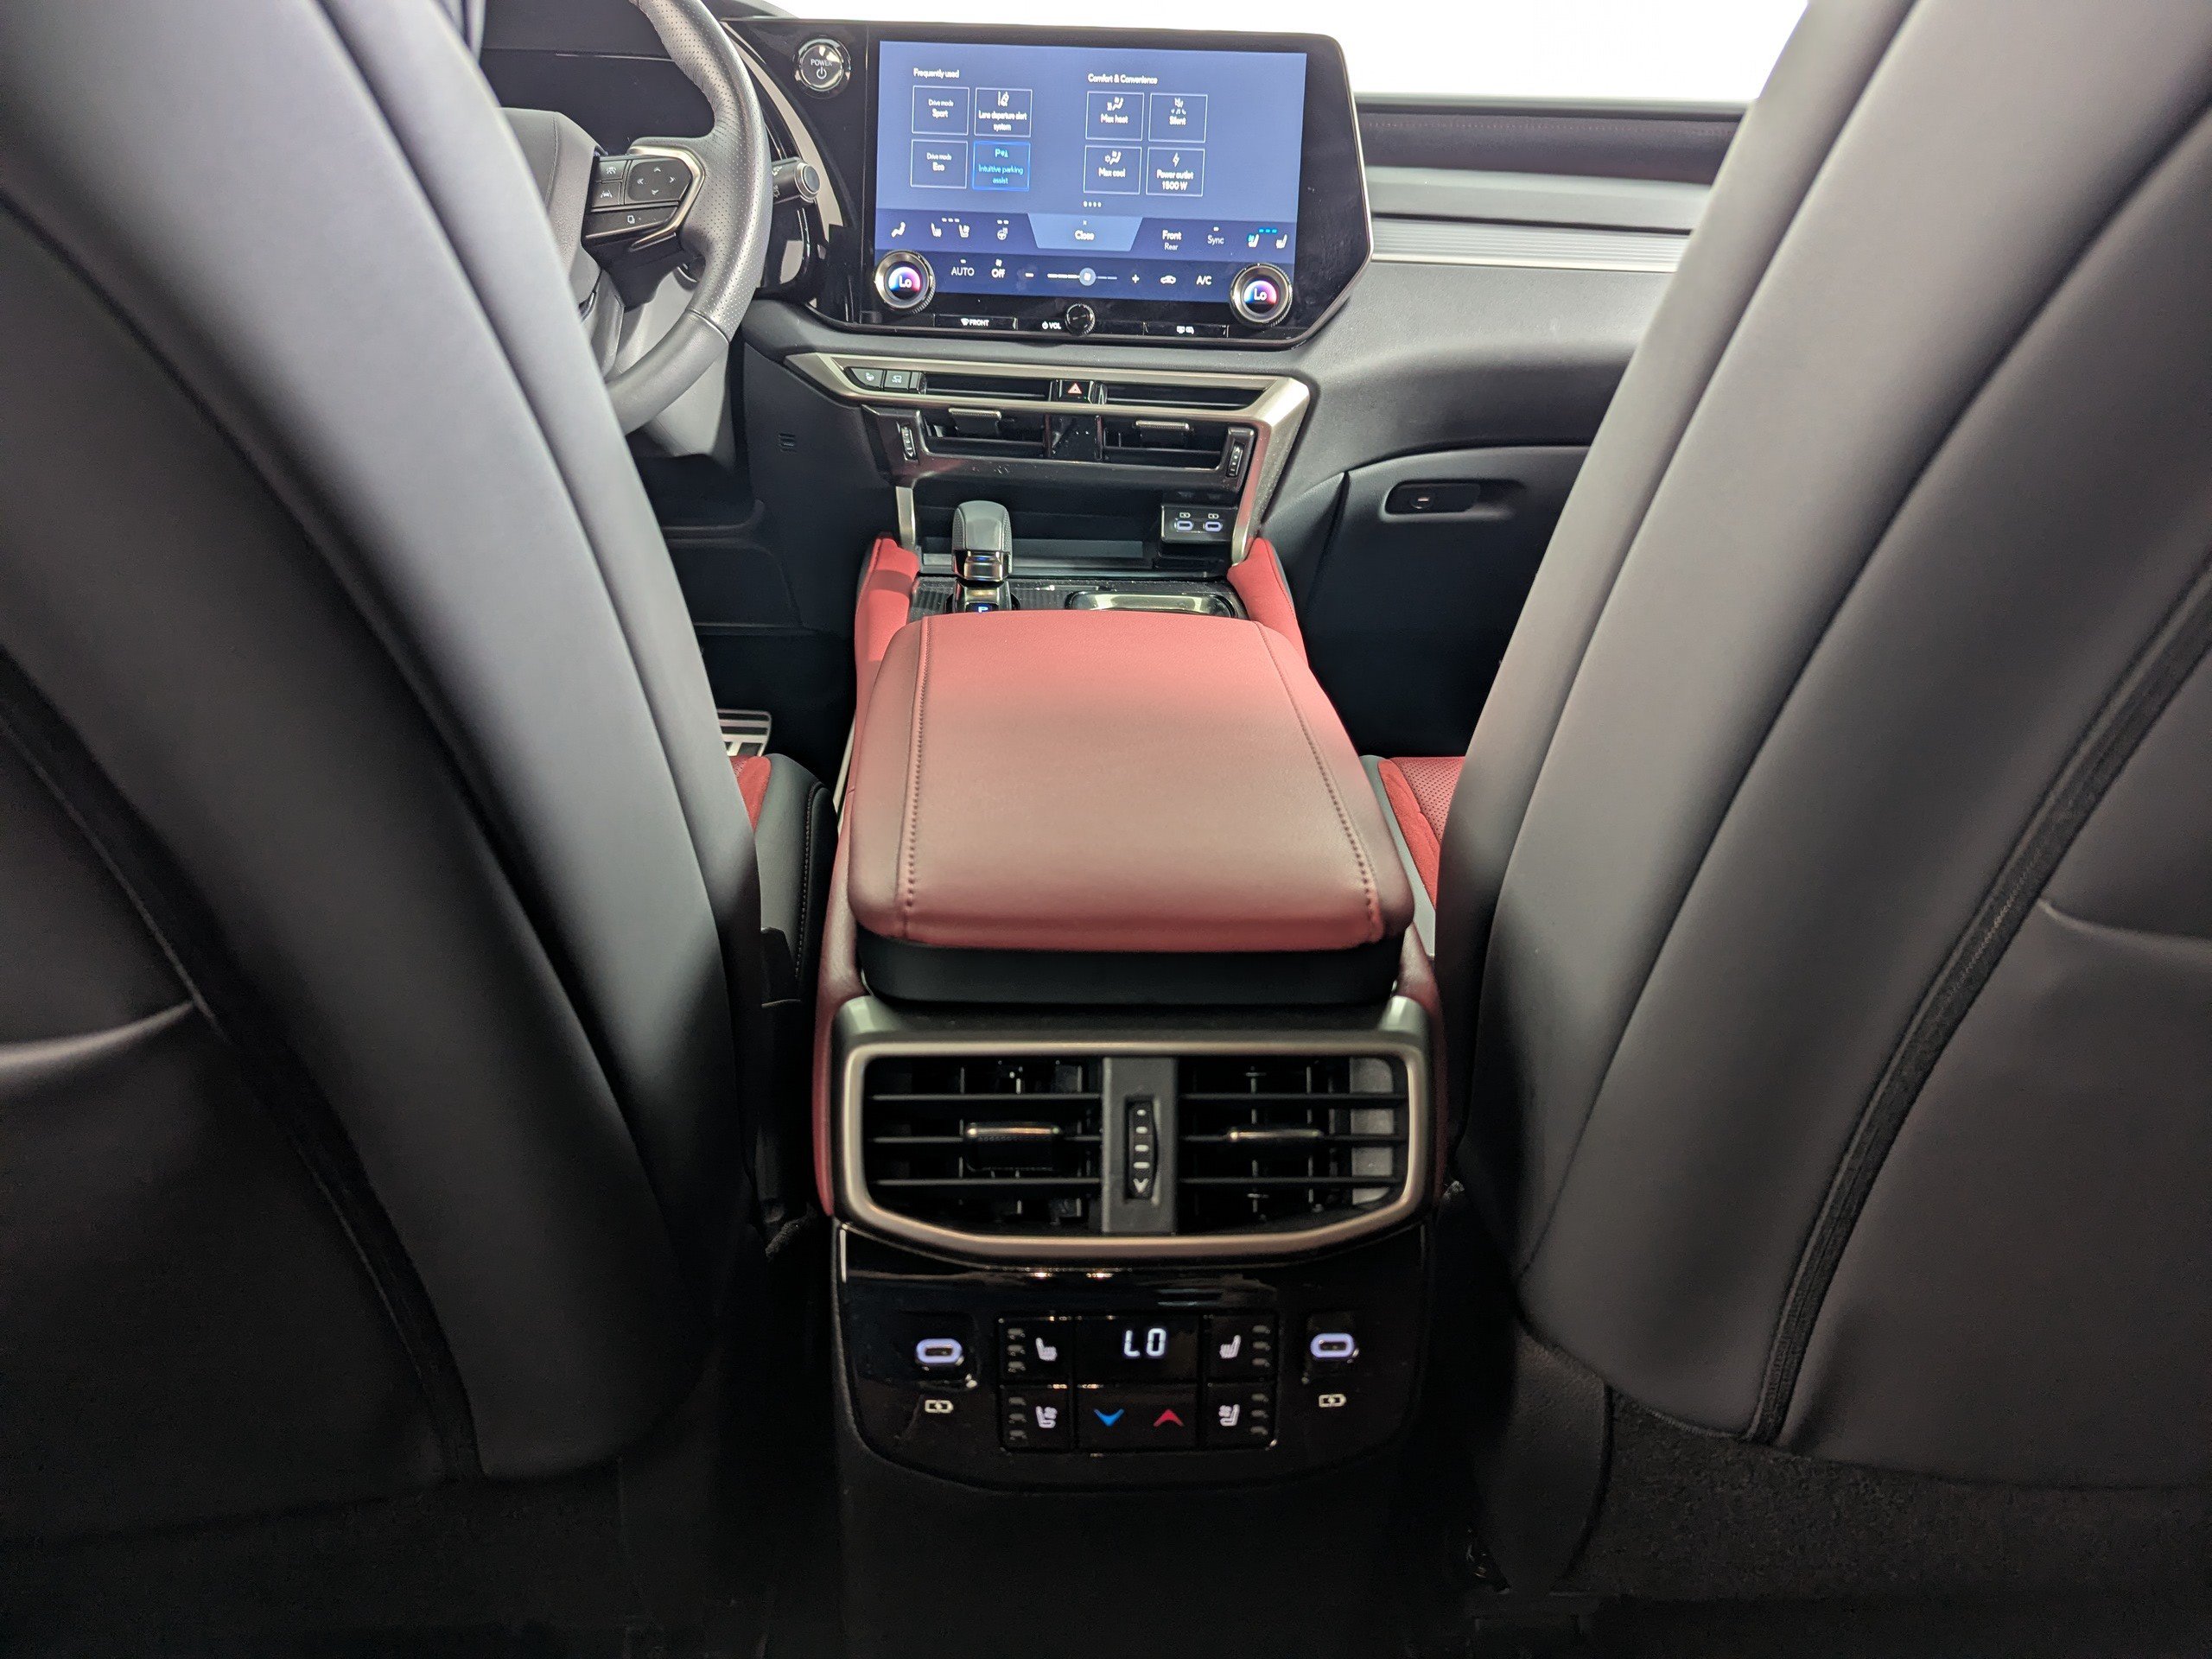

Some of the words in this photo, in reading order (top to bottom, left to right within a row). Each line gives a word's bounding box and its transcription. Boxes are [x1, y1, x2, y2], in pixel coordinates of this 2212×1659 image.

[810, 58, 833, 67] POWER
[913, 68, 944, 79] Frequently
[945, 70, 959, 79] used
[1088, 73, 1113, 83] Comfort
[1114, 74, 1119, 83] &
[1120, 74, 1158, 85] Convenience
[931, 108, 949, 118] Sport
[978, 110, 990, 119] Lane
[991, 111, 1015, 120] departure
[1015, 111, 1027, 120] alert
[1101, 113, 1114, 124] Max
[1115, 114, 1128, 124] heat
[1169, 116, 1186, 125] Silent
[993, 124, 1011, 132] system
[932, 162, 945, 171] Eco
[978, 164, 1001, 174] Intuitive
[1001, 166, 1024, 175] parking
[1098, 167, 1112, 177] Max
[1113, 168, 1126, 178] cool
[1156, 169, 1175, 179] Power
[1176, 170, 1193, 180] outlet
[1180, 181, 1188, 191] W
[1075, 230, 1095, 241] Close
[1162, 230, 1182, 241] Front
[1207, 235, 1224, 245] Sync
[1164, 243, 1179, 251] Rear
[951, 266, 975, 276] AUTO
[992, 268, 1005, 279] Off
[899, 276, 912, 289] Lo
[1197, 276, 1211, 286] A/C
[1254, 289, 1267, 302] Lo
[969, 319, 989, 327] FRONT
[1123, 1327, 1166, 1357] LO
